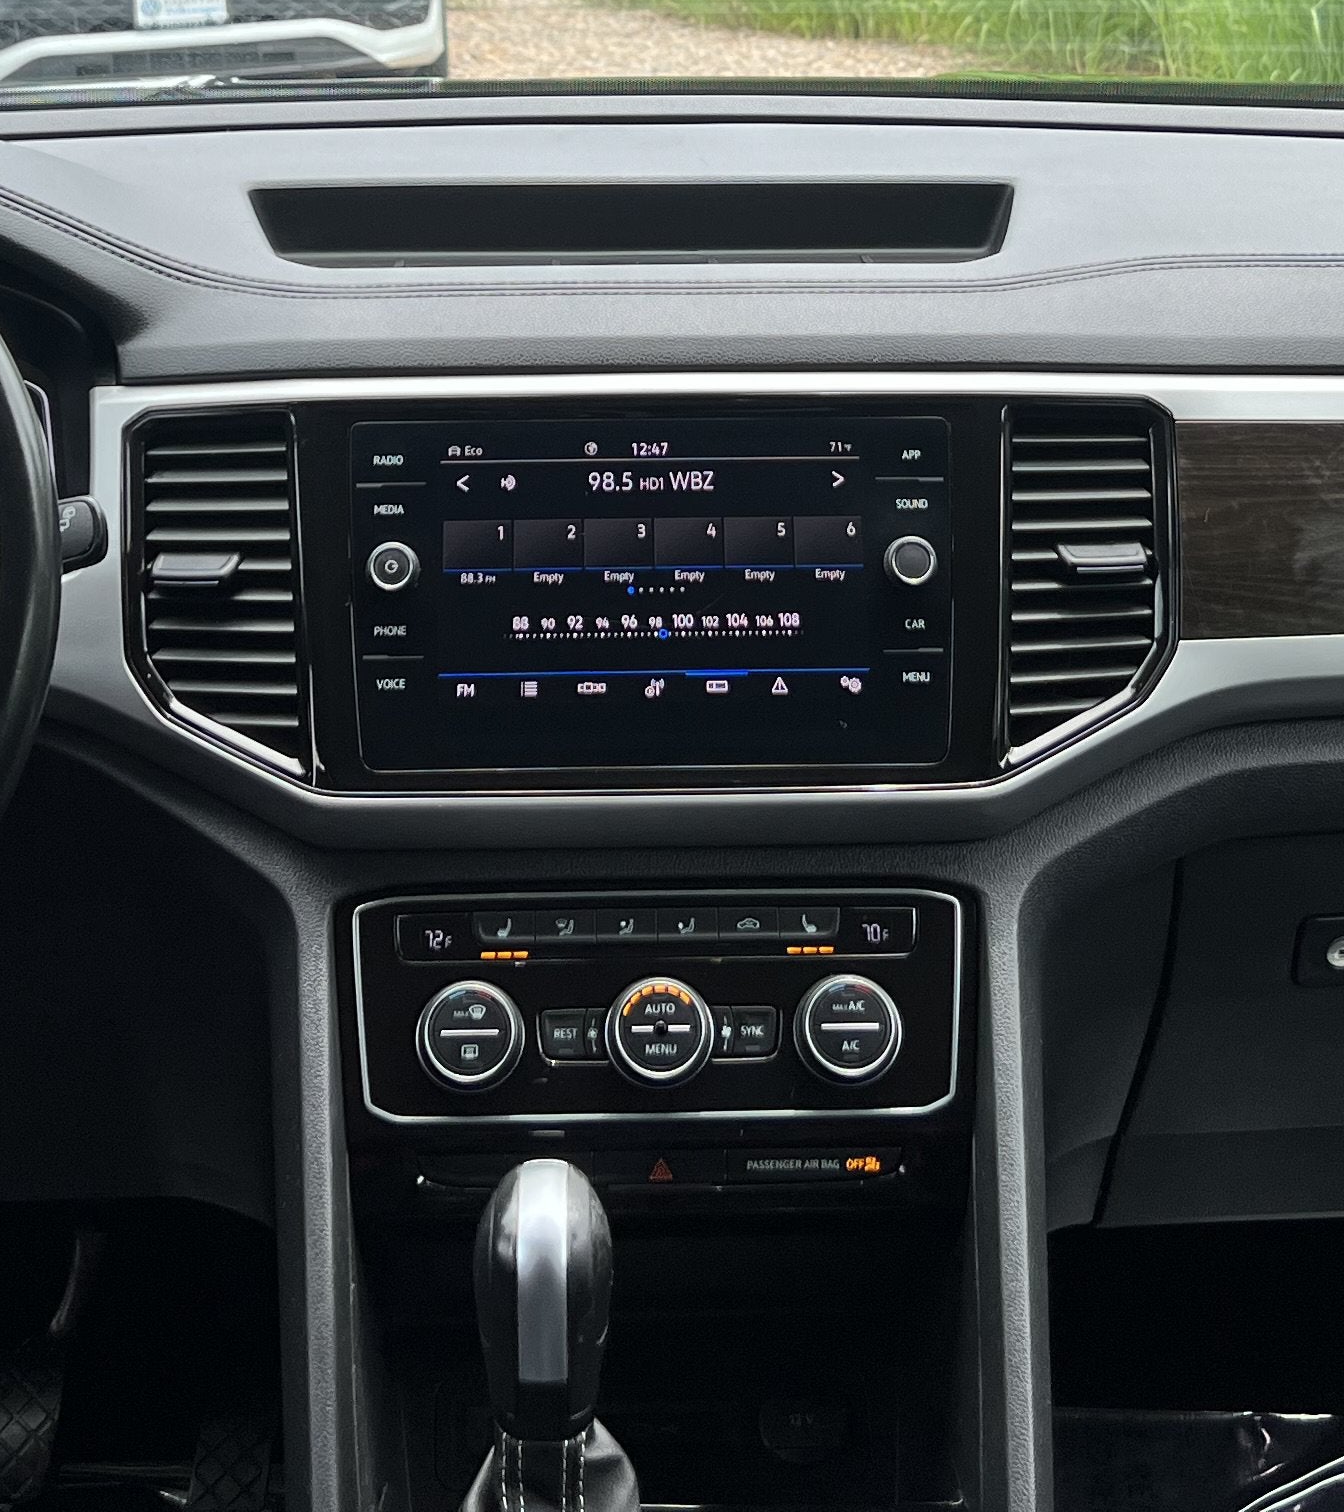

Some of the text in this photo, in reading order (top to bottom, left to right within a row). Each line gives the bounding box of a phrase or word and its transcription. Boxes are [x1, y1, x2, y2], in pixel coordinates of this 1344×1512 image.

[464, 445, 483, 457] Eco
[631, 441, 668, 457] 12:47
[901, 449, 921, 460] APP
[372, 454, 404, 466] RADIO
[588, 470, 715, 492] 98.5 HD1 WBZ
[373, 504, 405, 515] MEDIA
[895, 498, 929, 510] SOUND
[497, 525, 504, 541] 1
[567, 524, 576, 540] 2
[637, 523, 646, 539] 3
[706, 522, 717, 539] 4
[777, 522, 786, 537] 5
[846, 521, 856, 536] 6
[460, 572, 484, 584] 88.3
[533, 571, 564, 585] Empty
[604, 570, 635, 584] Empty
[674, 569, 705, 583] Empty
[744, 568, 776, 583] Empty
[815, 567, 846, 582] Empty
[512, 612, 800, 631] 88 90 92 94 96 98 100 102 104 106 108
[904, 618, 926, 630] CAR
[373, 625, 407, 637] PHONE
[376, 678, 406, 690] VOICE
[902, 671, 931, 683] MENU
[456, 683, 475, 698] FM
[425, 929, 444, 949] 72
[861, 923, 881, 942] 70
[644, 1002, 676, 1015] AUTO
[848, 999, 865, 1011] A/C
[553, 1027, 577, 1039] REST
[740, 1025, 764, 1037] SYNC
[645, 1043, 678, 1055] MENU
[841, 1039, 860, 1051] A/C
[746, 1157, 865, 1171] PASSENGER AIR BAG OFF
